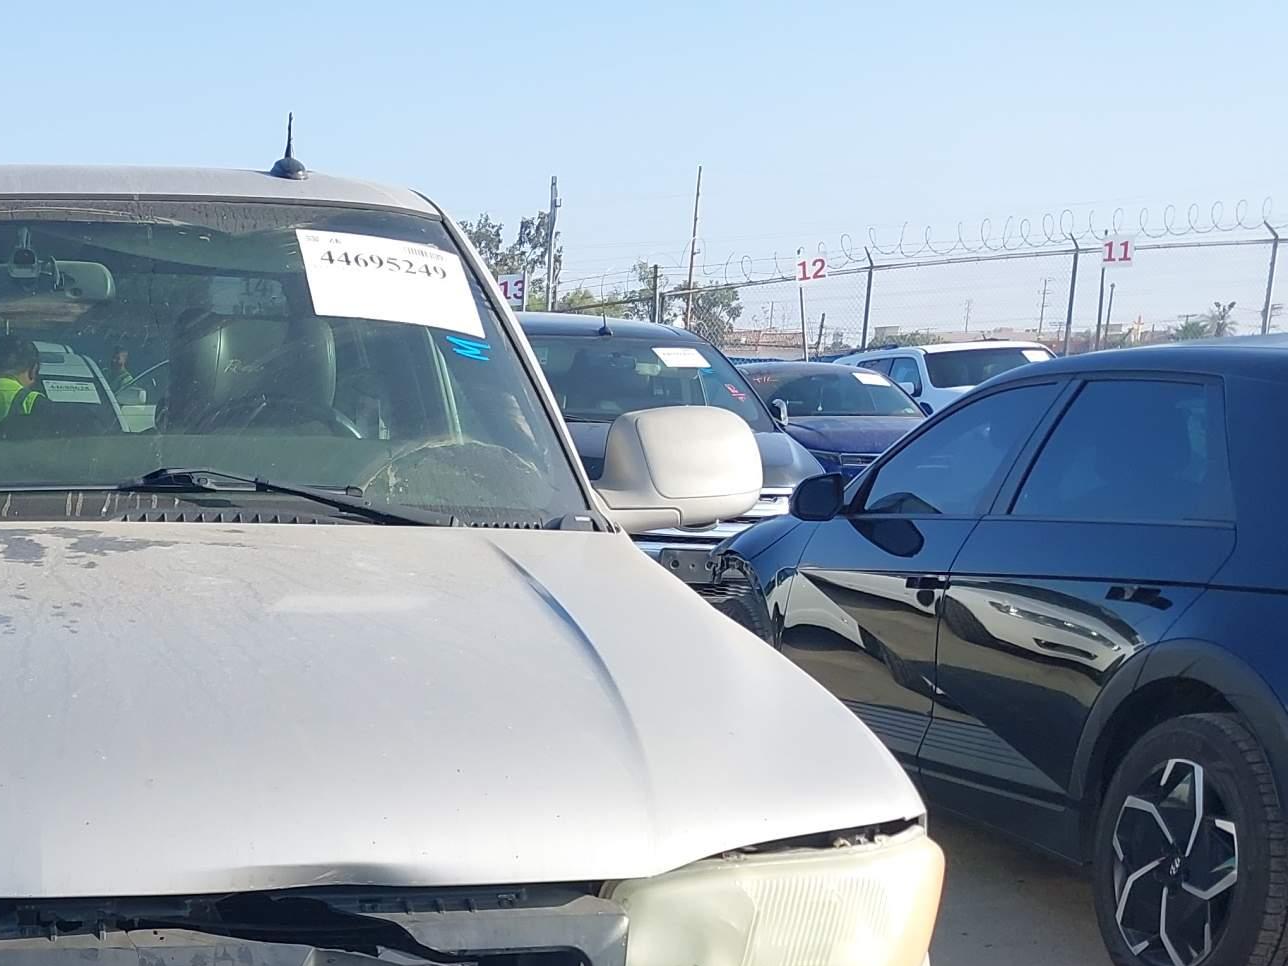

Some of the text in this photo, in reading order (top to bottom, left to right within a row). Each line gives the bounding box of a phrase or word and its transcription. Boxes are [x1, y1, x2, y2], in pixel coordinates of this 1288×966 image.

[1103, 240, 1132, 262] 11
[320, 250, 448, 279] 44695249
[797, 258, 827, 280] 12
